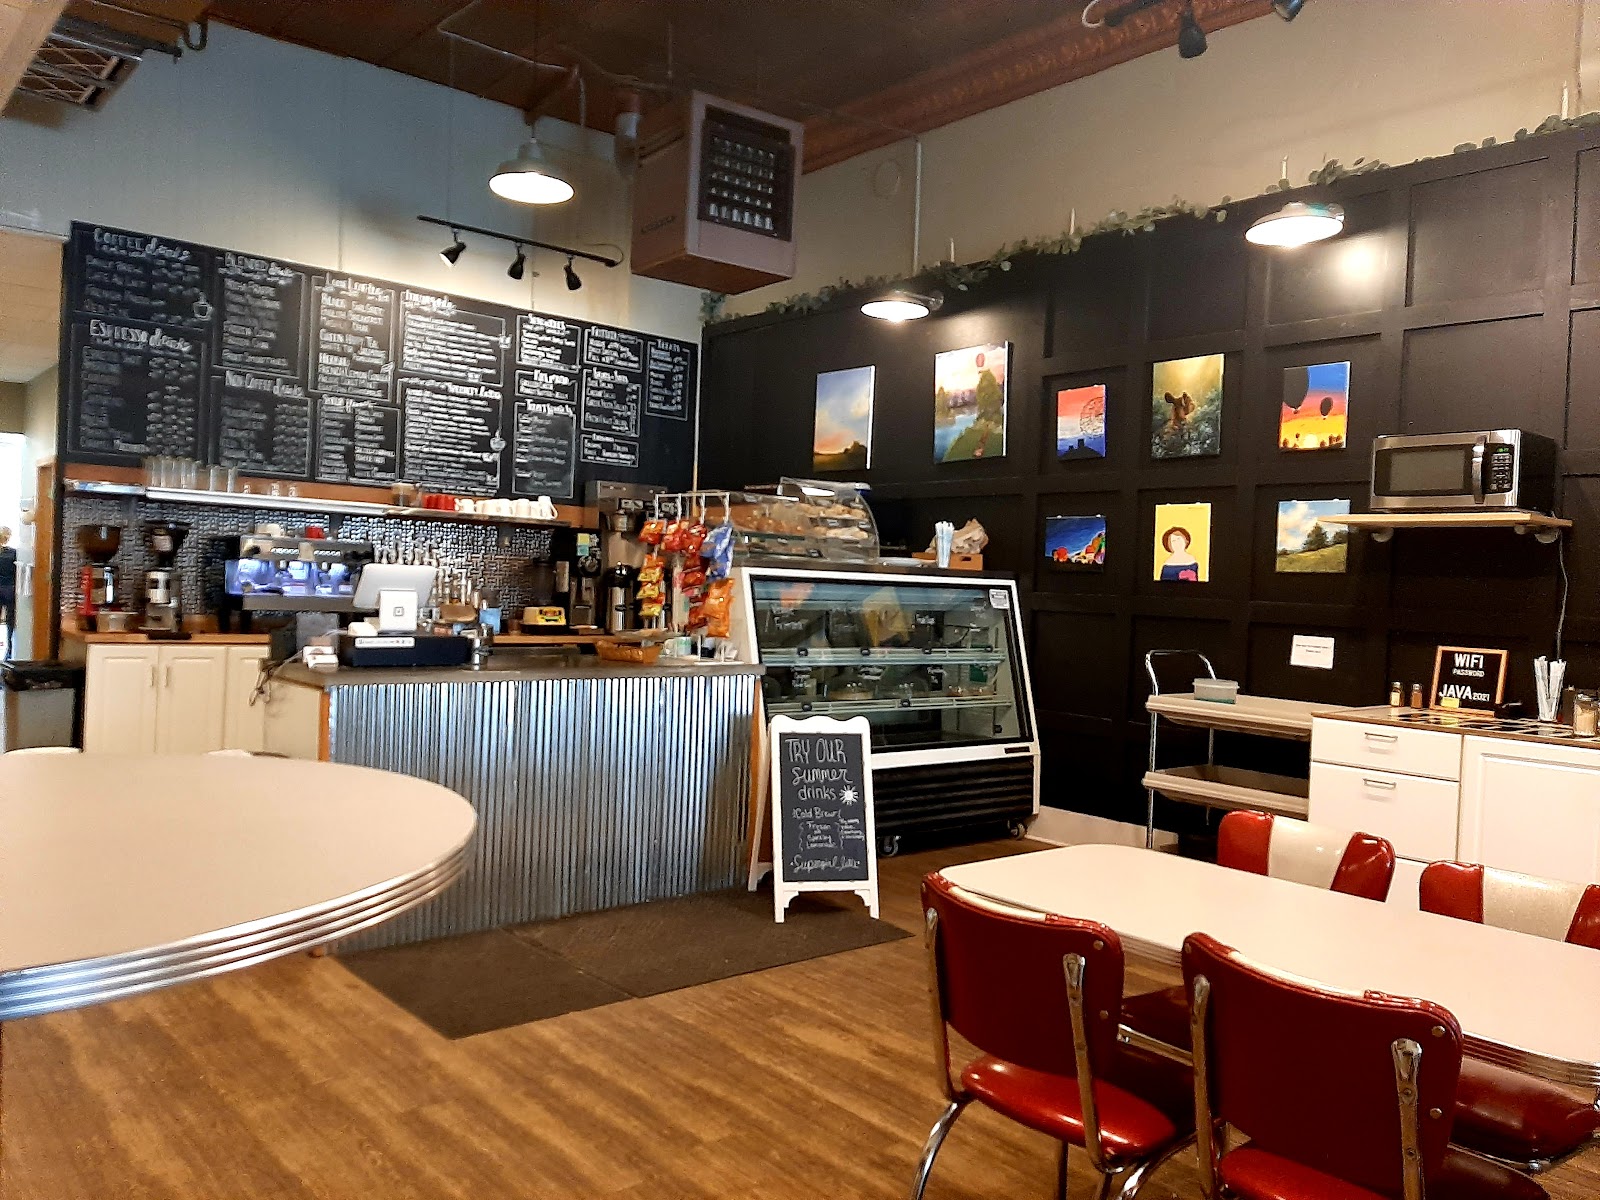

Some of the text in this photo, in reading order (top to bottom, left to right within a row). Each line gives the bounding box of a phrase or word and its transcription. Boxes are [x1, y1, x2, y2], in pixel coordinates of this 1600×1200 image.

[1454, 653, 1484, 669] WIFI
[1452, 669, 1485, 677] PASSWORD
[784, 738, 846, 764] TRY OUR
[791, 767, 853, 786] Summer
[798, 785, 837, 800] drinks
